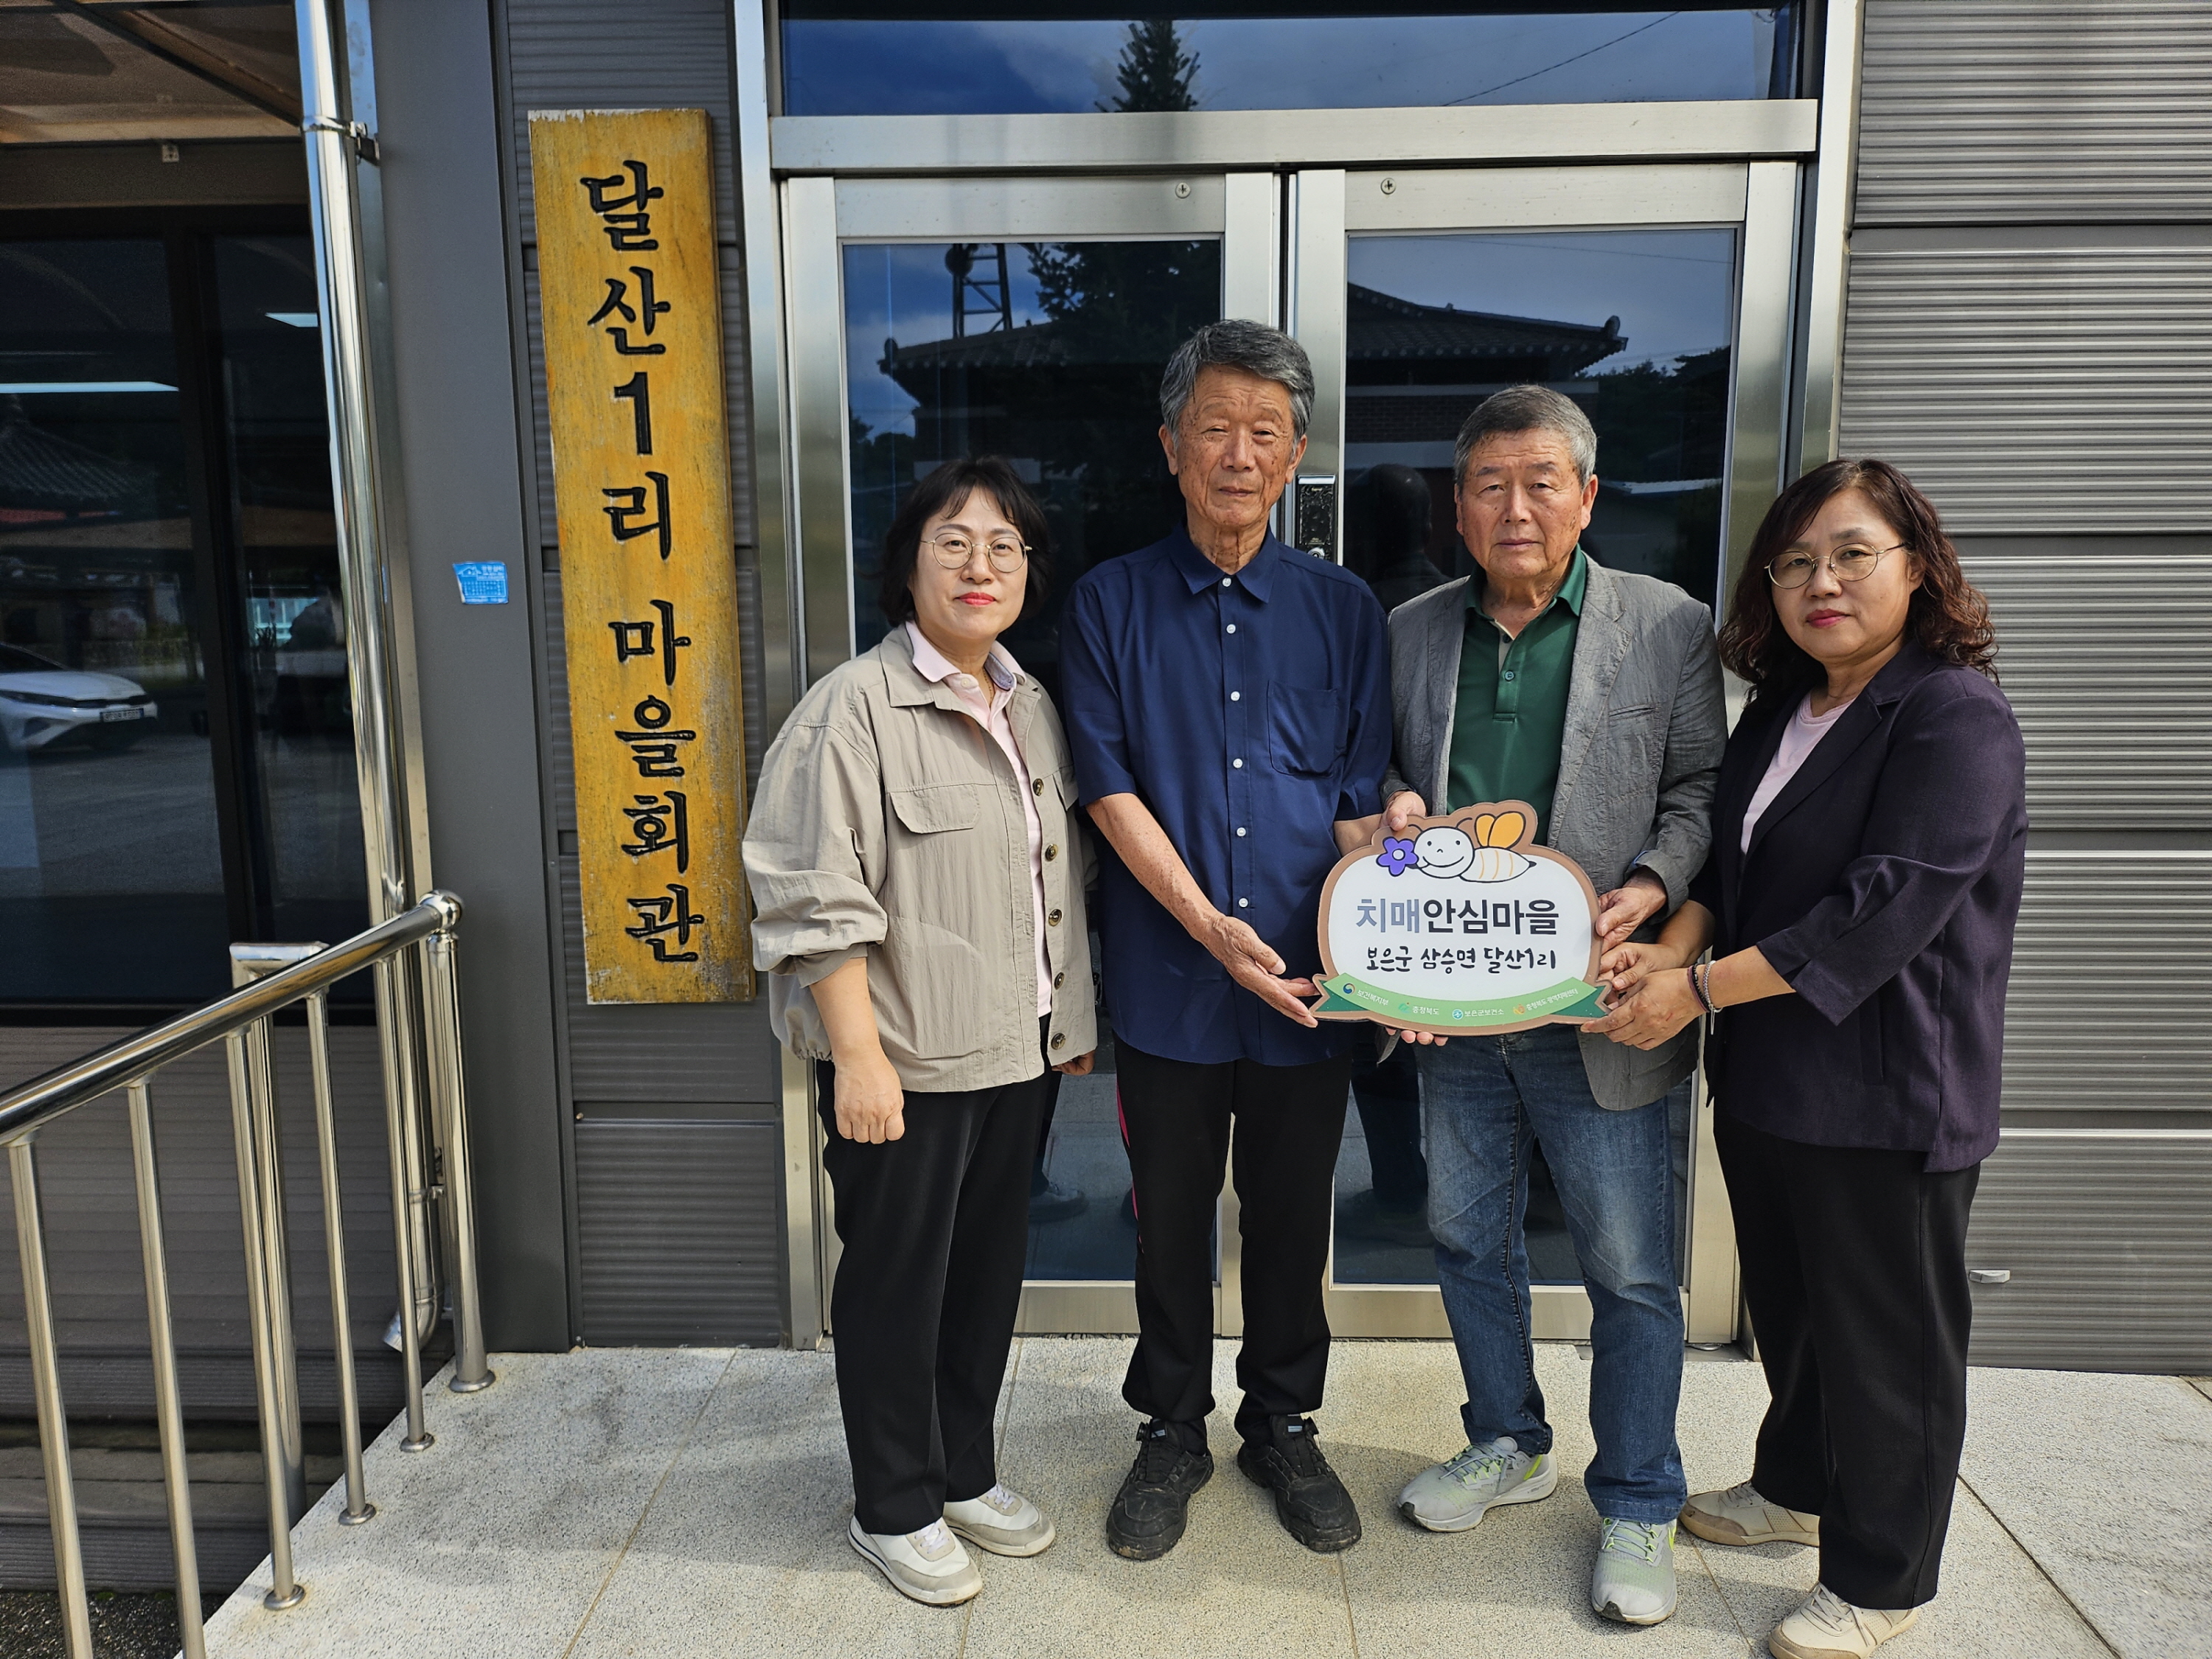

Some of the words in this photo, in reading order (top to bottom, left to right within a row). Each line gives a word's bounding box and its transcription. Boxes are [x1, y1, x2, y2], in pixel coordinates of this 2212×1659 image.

[580, 160, 671, 560] 달산1리
[608, 600, 704, 963] 마을회관
[1356, 898, 1559, 936] 치매안심마을
[1366, 946, 1413, 973] 보은군
[1420, 947, 1475, 975] 삼승면
[1484, 947, 1556, 974] 달산1리
[1357, 990, 1389, 1006] 보건복지부
[1412, 1006, 1439, 1015] 충청북도
[1526, 998, 1548, 1011] 충청북도
[1546, 988, 1579, 1004] 광역치매센터
[1464, 1009, 1504, 1017] 보은군보건소
